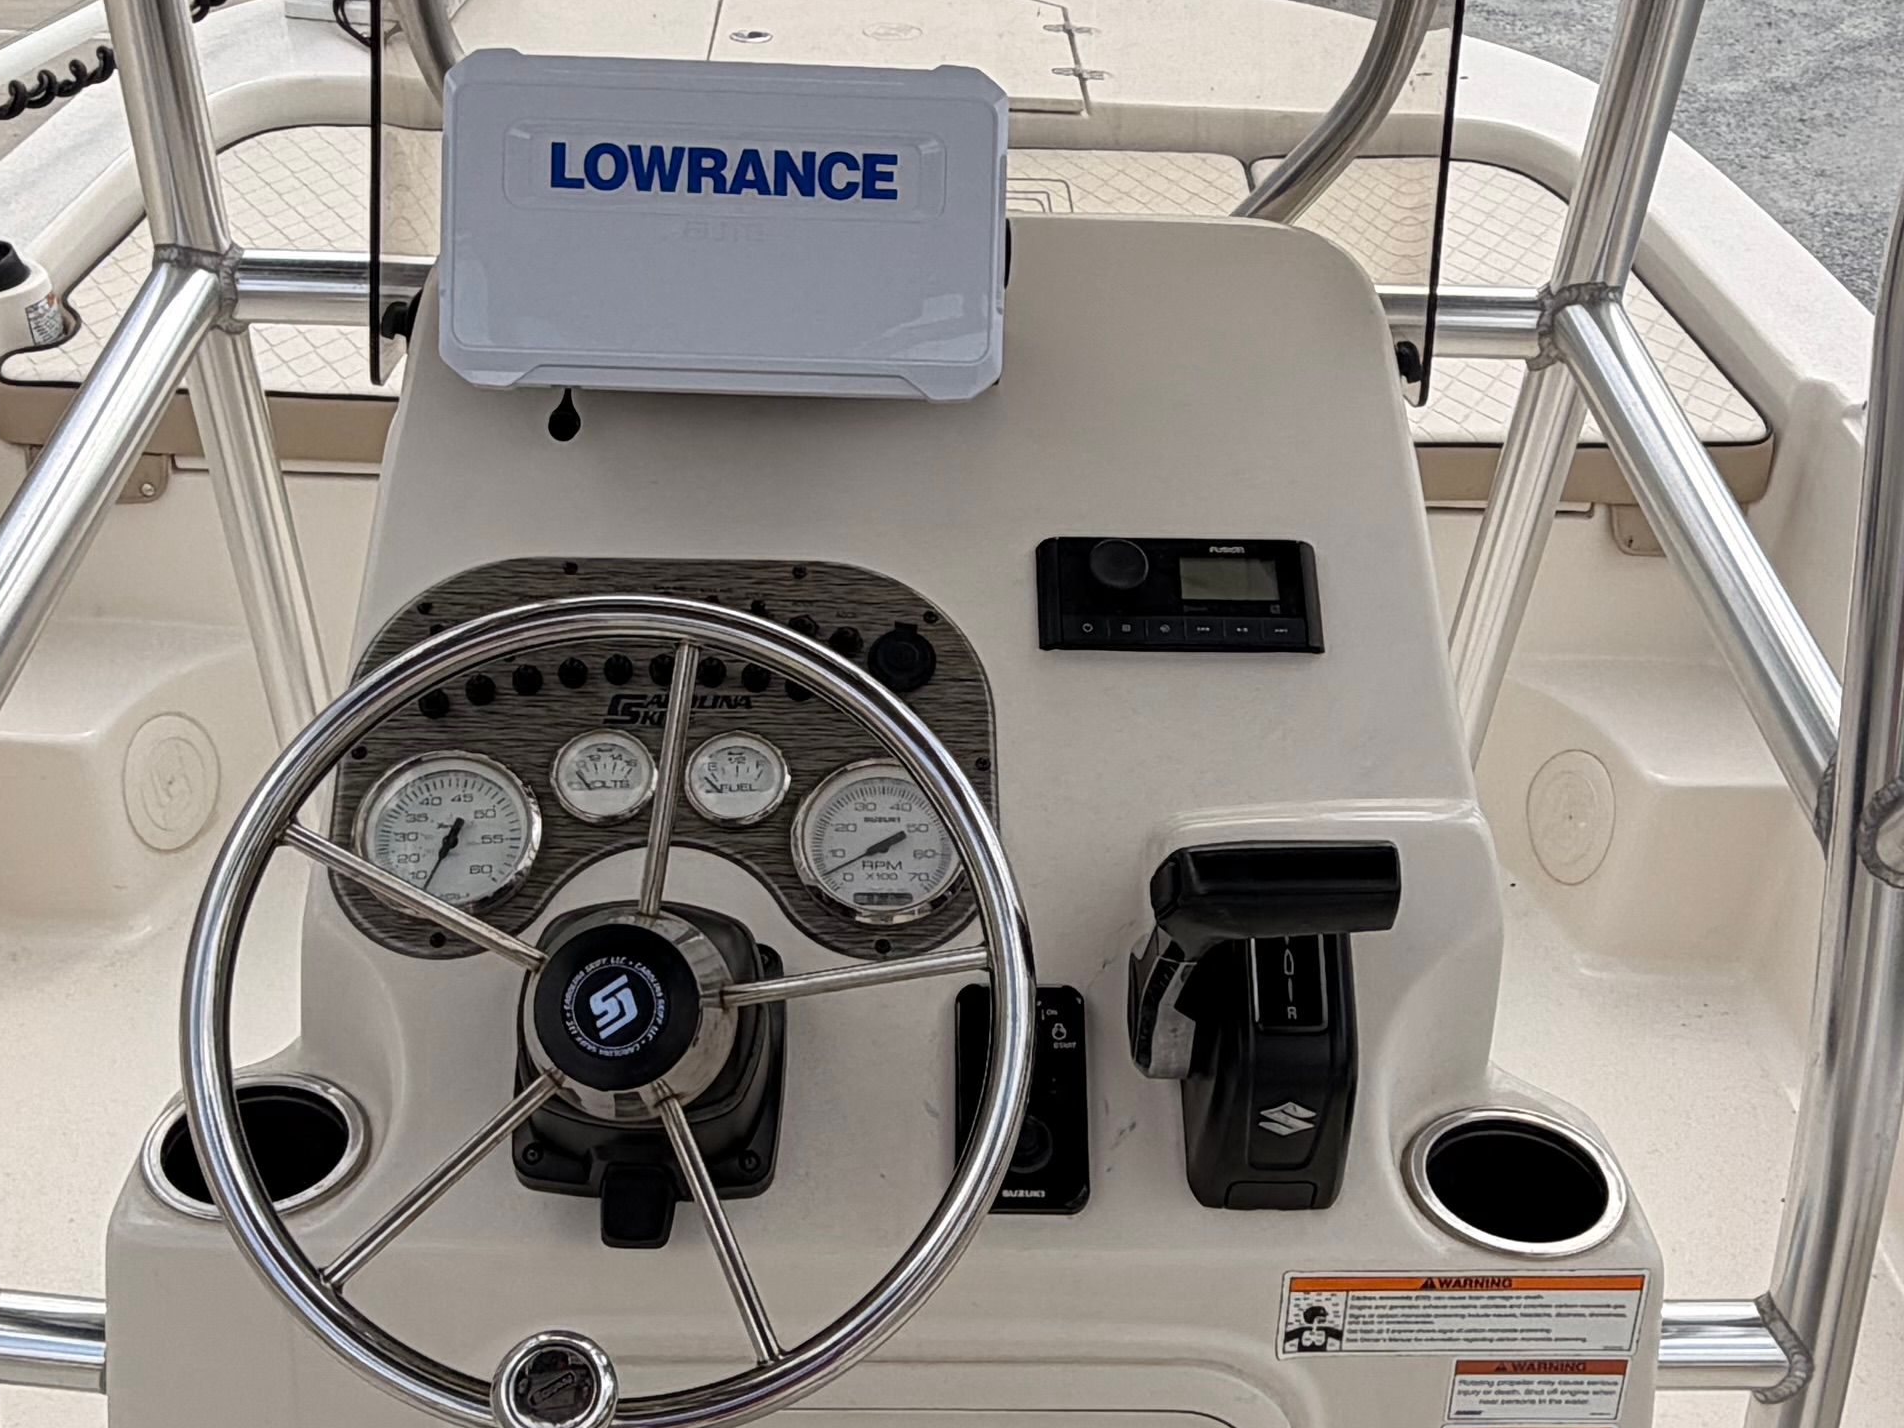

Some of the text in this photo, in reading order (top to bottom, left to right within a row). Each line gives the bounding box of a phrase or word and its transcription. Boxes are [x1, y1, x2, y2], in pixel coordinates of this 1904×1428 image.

[550, 141, 898, 201] LOWRANCE
[608, 694, 752, 715] CALINA
[720, 783, 758, 792] FUEL
[420, 797, 441, 806] 40
[451, 794, 473, 802] 45
[855, 803, 876, 812] 30
[889, 803, 912, 812] 40
[406, 813, 428, 822] 35
[835, 824, 856, 832] 20
[907, 824, 928, 833] 50
[396, 832, 418, 842] 30
[481, 835, 504, 843] 55
[830, 849, 845, 857] 10
[913, 849, 935, 859] 60
[398, 854, 420, 863] 20
[862, 861, 903, 870] RPM
[908, 873, 929, 881] 70
[1287, 1006, 1297, 1020] R
[1002, 1189, 1046, 1198] SUZUKI
[1439, 1277, 1513, 1289] WARNING
[1511, 1361, 1587, 1372] WARNING
